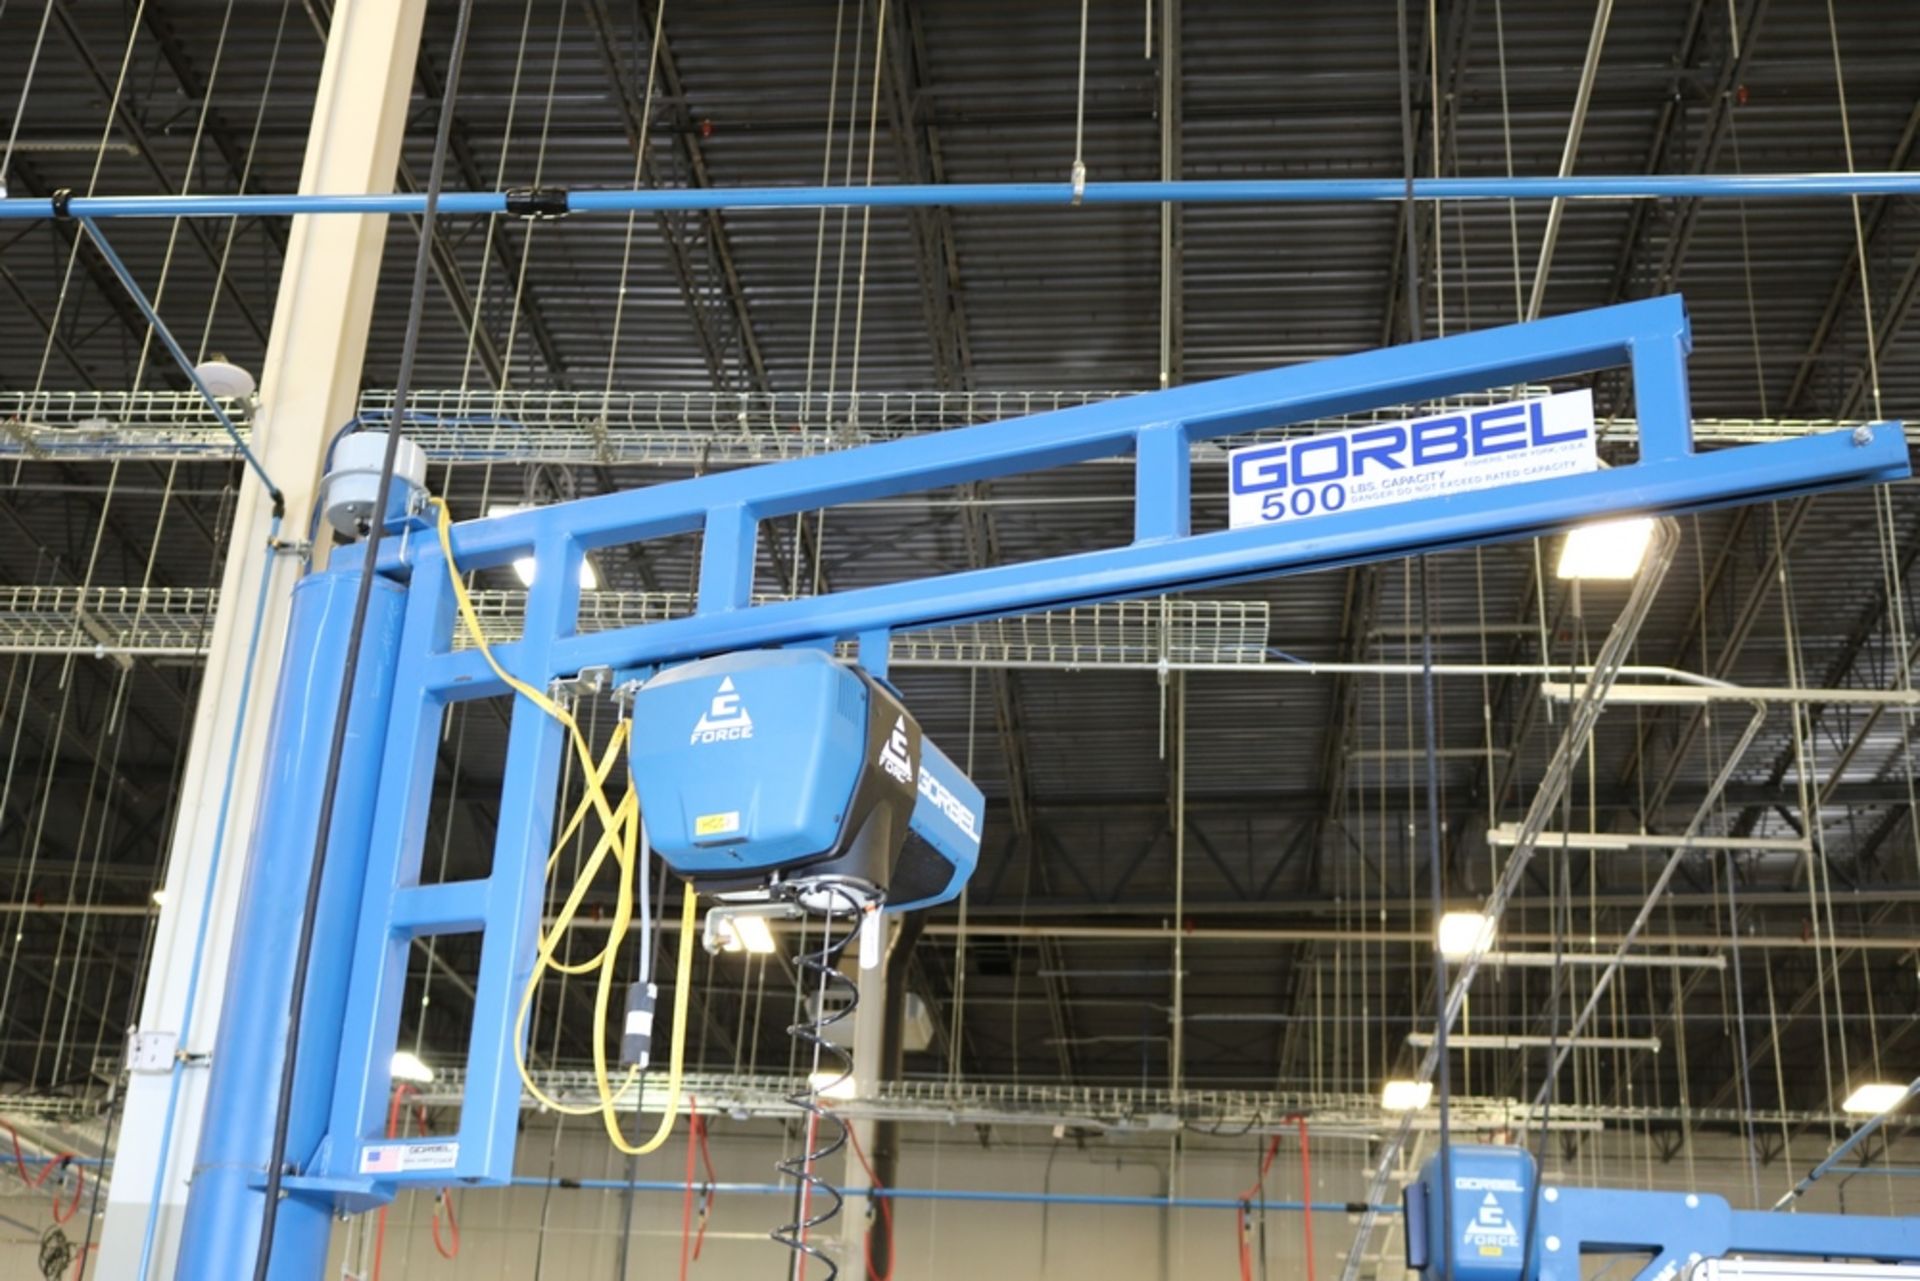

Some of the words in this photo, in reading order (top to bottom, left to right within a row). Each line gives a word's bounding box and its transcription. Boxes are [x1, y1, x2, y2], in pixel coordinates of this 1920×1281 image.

[1232, 402, 1588, 496] GORBEL
[1260, 483, 1347, 521] 500
[1382, 470, 1447, 489] CAPACITY
[1351, 491, 1393, 505] DANGER
[1397, 487, 1412, 496] DO
[1415, 483, 1437, 493] NOT
[1440, 476, 1483, 489] EXCEED
[1485, 470, 1520, 482] RATED
[1524, 460, 1578, 476] CAPACITY
[690, 724, 753, 746] FORCE
[917, 766, 980, 844] GORBEL
[1463, 1234, 1520, 1248] FORCE
